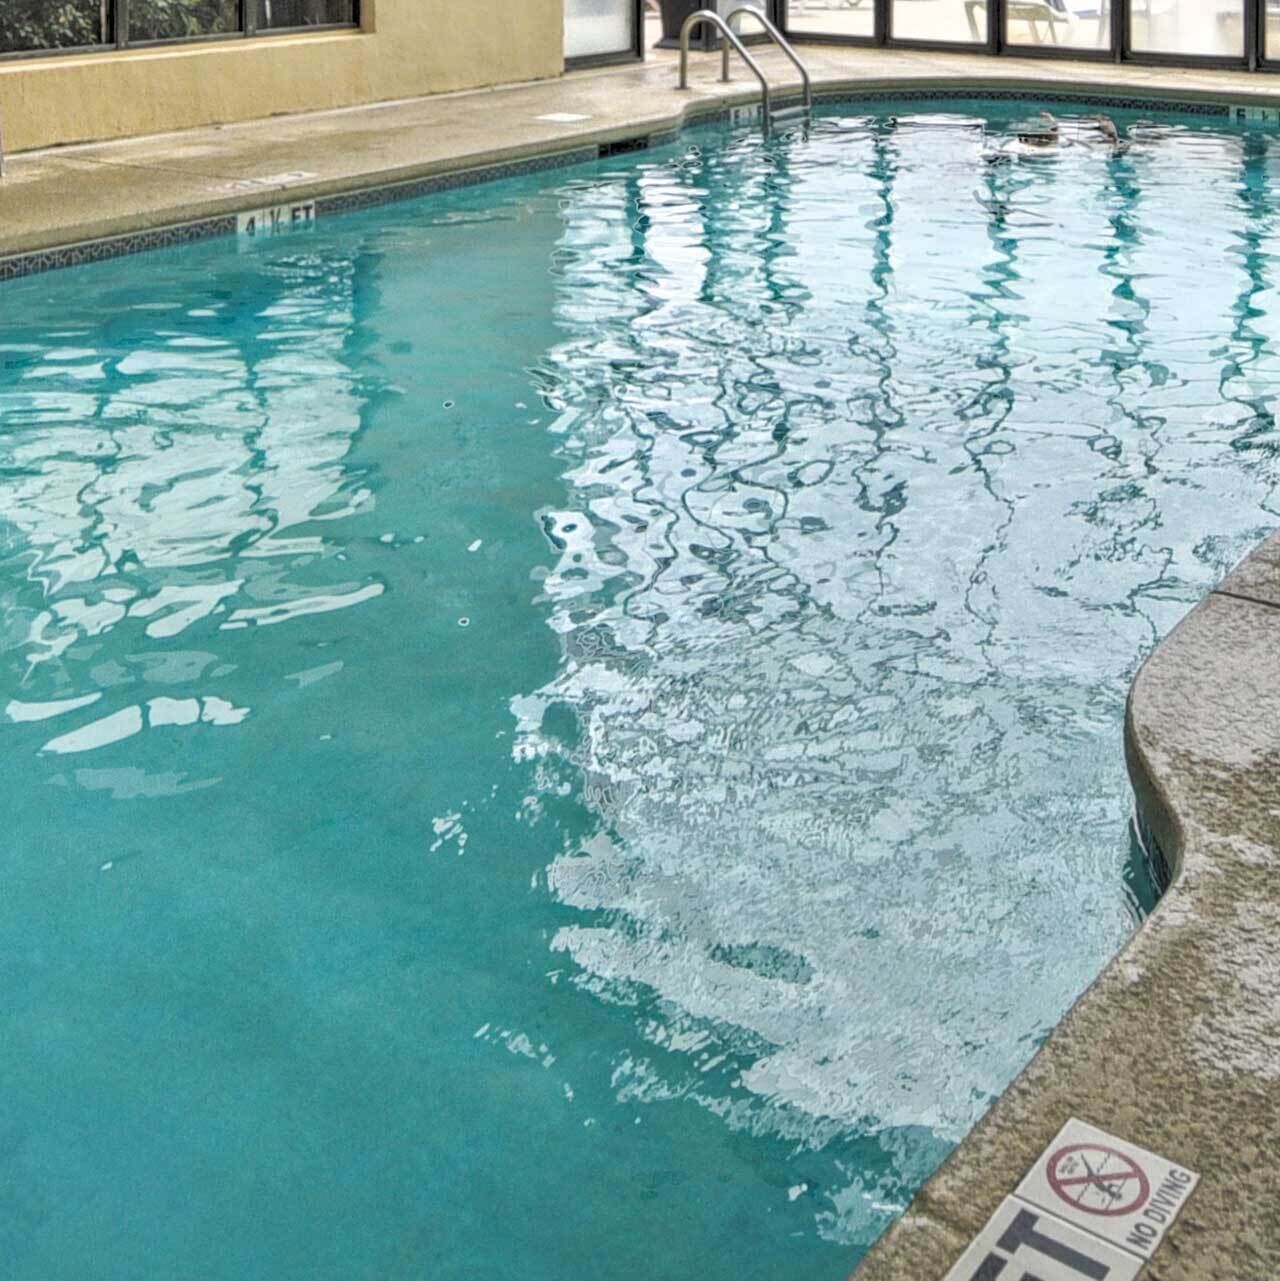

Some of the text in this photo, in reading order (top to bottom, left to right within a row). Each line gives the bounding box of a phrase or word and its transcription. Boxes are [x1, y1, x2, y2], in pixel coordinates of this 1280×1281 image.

[291, 205, 314, 226] FT
[1126, 1168, 1194, 1251] NO DIVING
